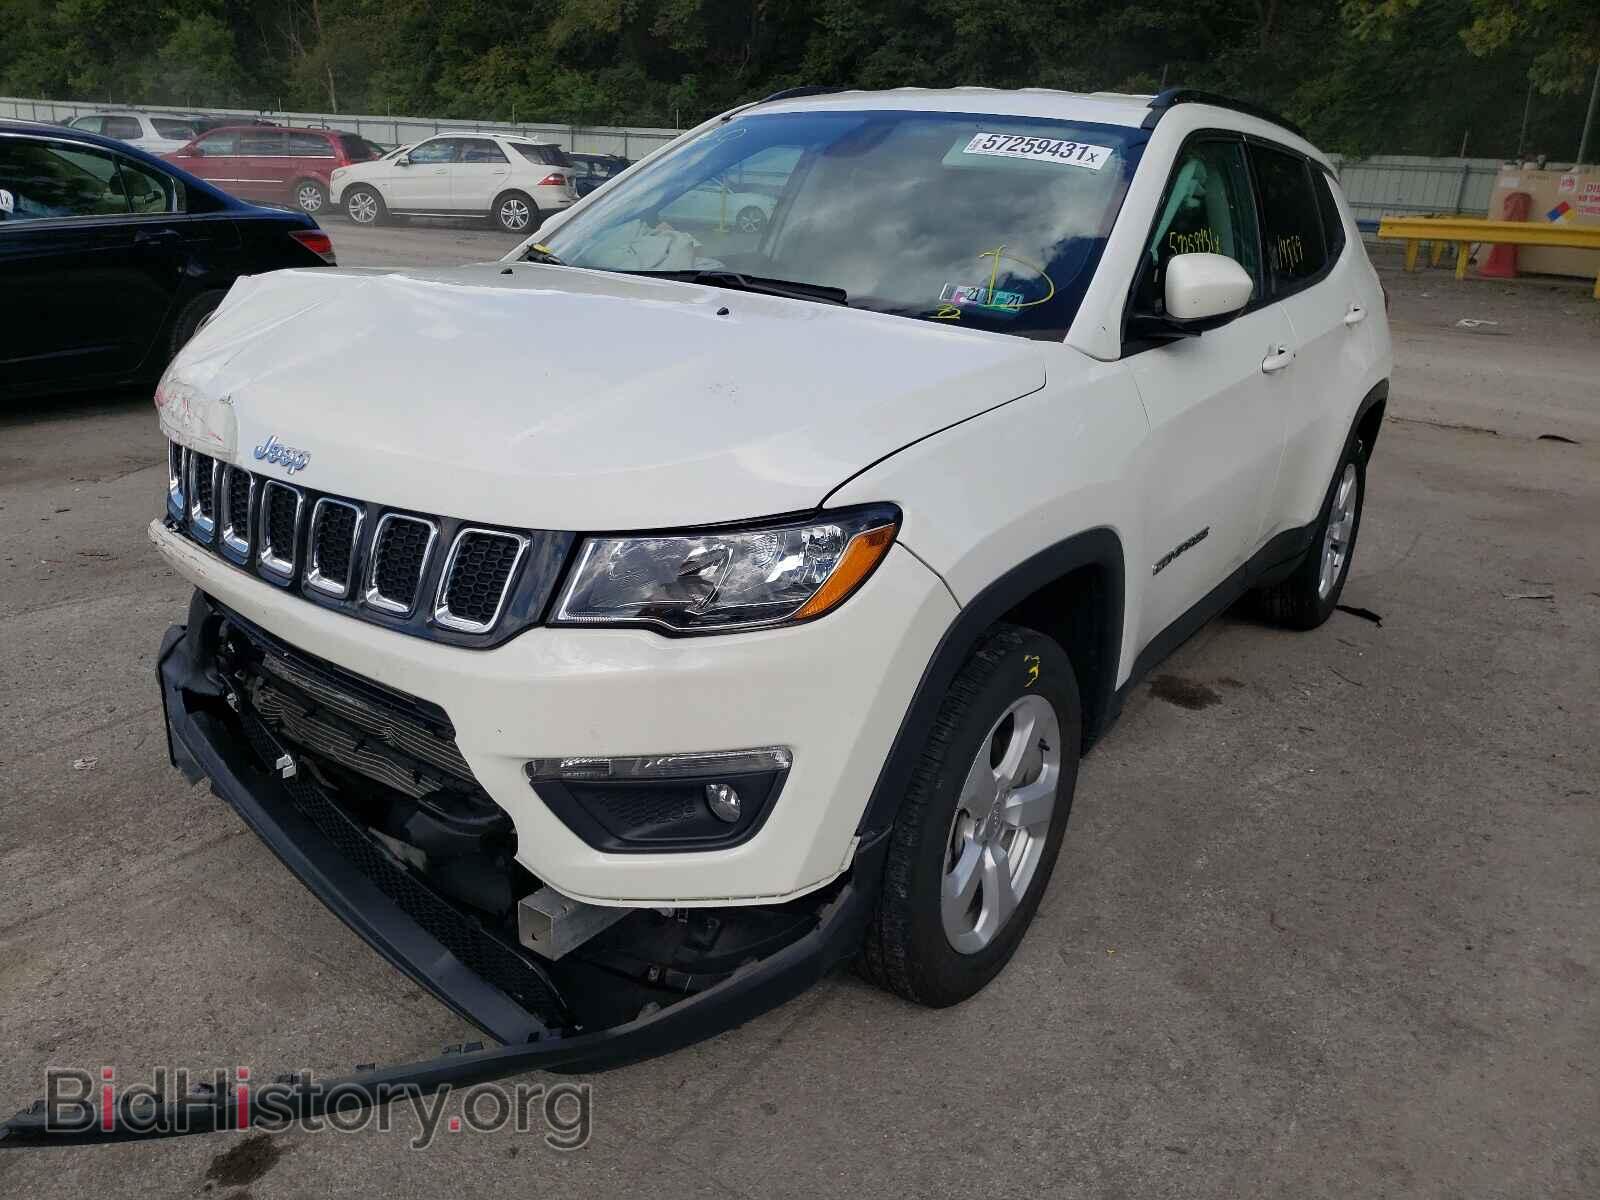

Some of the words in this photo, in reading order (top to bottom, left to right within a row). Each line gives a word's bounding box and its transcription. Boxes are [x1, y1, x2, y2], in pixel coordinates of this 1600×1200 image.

[967, 287, 981, 302] 21
[1008, 294, 1021, 306] 21
[254, 434, 311, 475] Jeep
